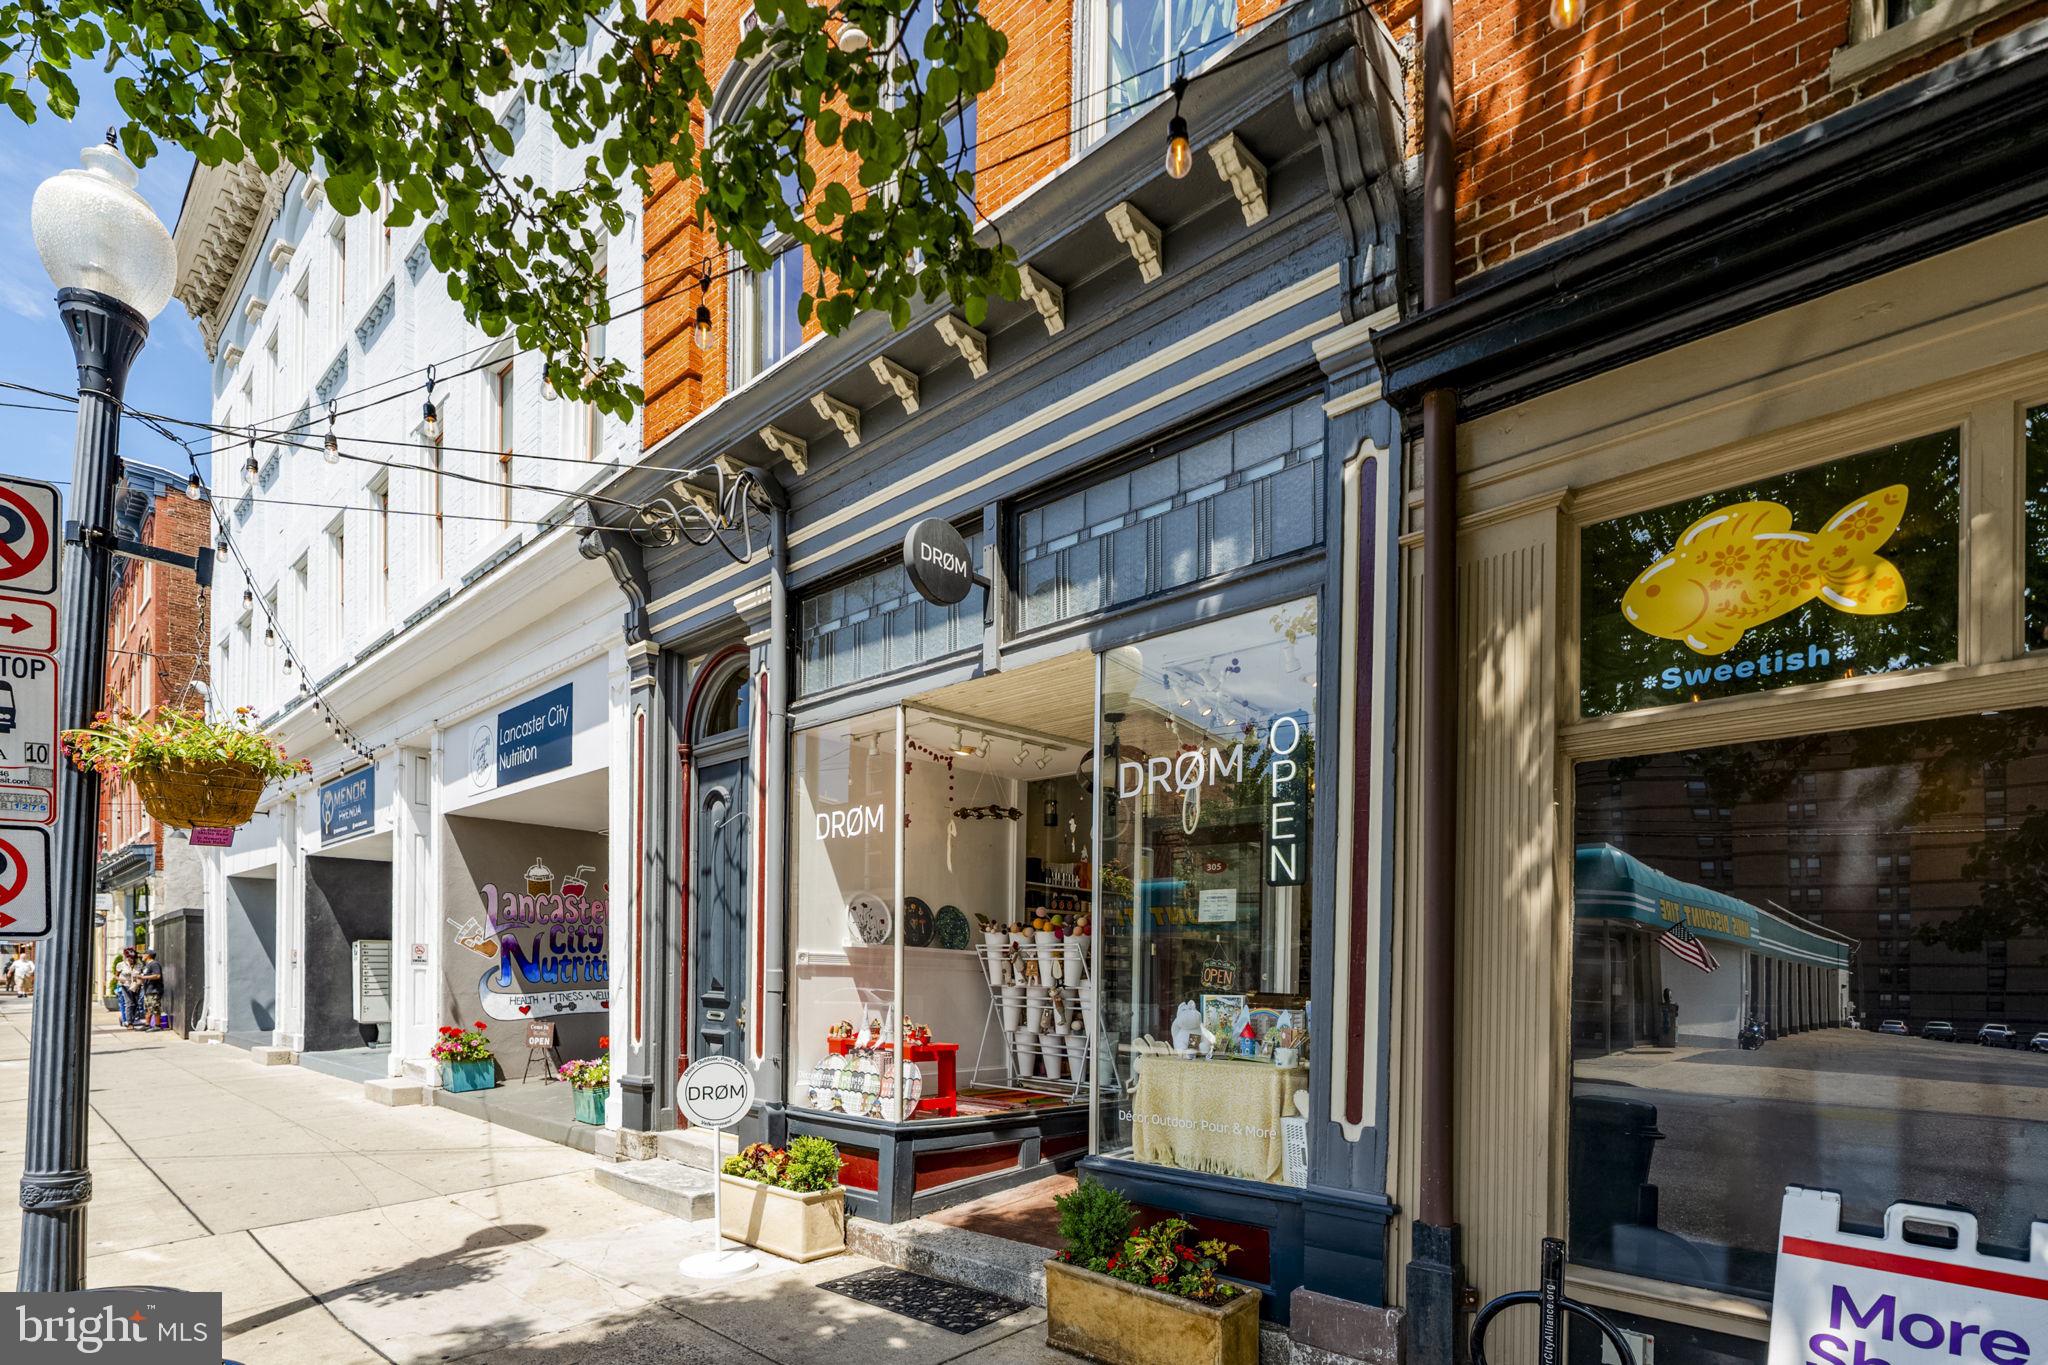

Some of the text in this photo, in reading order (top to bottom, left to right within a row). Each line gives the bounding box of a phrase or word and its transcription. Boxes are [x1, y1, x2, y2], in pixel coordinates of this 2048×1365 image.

[920, 542, 968, 578] DRØM
[1661, 644, 1831, 690] Sweetish
[499, 704, 569, 745] Lancaster City
[26, 744, 48, 763] 10
[499, 745, 537, 770] Nutrition
[1119, 744, 1244, 799] DRØM
[333, 779, 367, 806] MENOR
[1270, 716, 1301, 882] OPEN
[815, 803, 884, 841] DRØM
[1206, 863, 1222, 871] 305
[549, 924, 604, 954] City
[1203, 967, 1233, 985] OPEN
[509, 995, 539, 1006] HEALTH
[549, 991, 584, 1004] FITNESS
[528, 1037, 550, 1046] OPEN
[688, 1084, 745, 1101] DRØM
[1233, 1122, 1242, 1135] &
[1245, 1125, 1277, 1139] More
[1543, 1284, 1556, 1365] rCityAlliance.org
[1829, 1284, 2031, 1365] More
